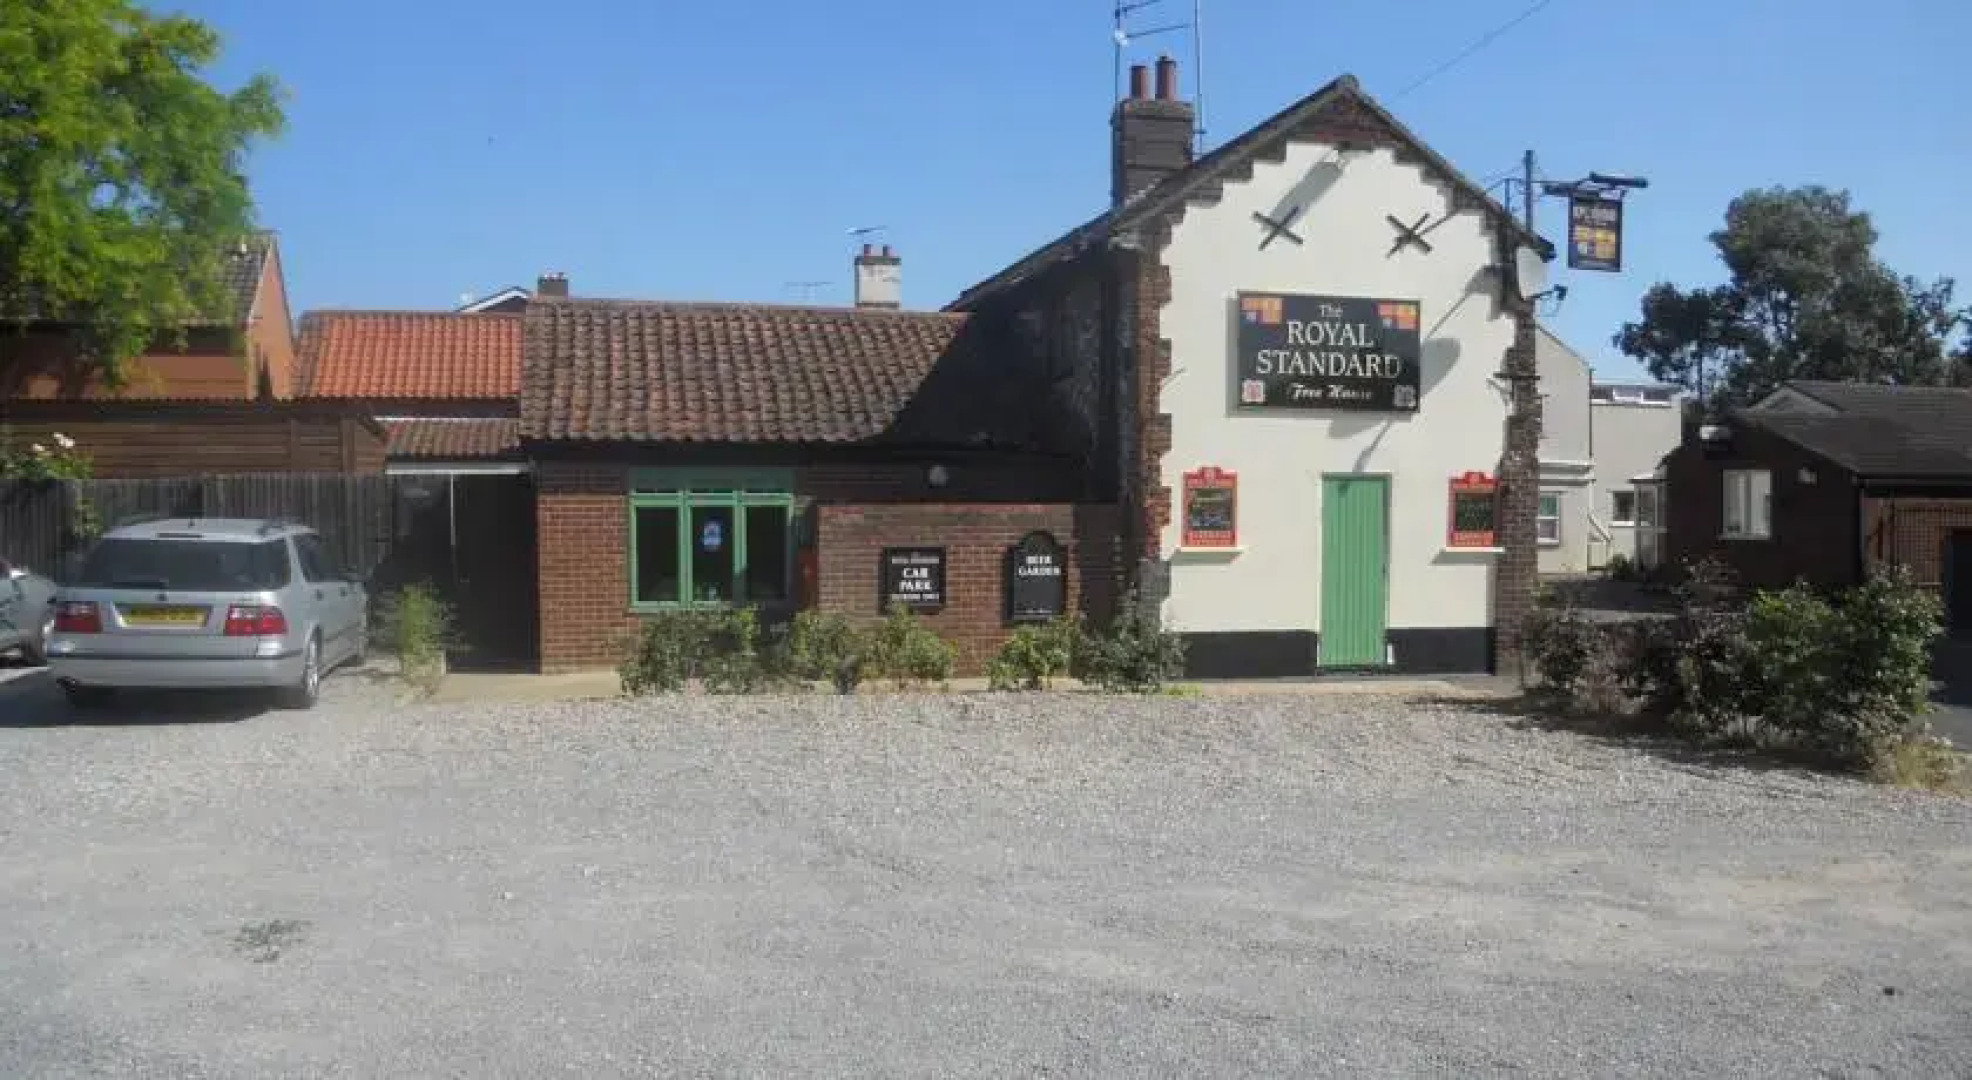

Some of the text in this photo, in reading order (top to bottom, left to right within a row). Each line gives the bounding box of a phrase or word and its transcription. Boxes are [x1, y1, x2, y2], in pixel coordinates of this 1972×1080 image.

[1318, 304, 1344, 318] The
[1286, 321, 1374, 348] ROYAL
[1255, 349, 1401, 379] STANDARD
[1026, 555, 1053, 565] BEER
[902, 567, 928, 579] CAR
[1018, 566, 1061, 577] GARDEN
[899, 580, 932, 592] PARK
